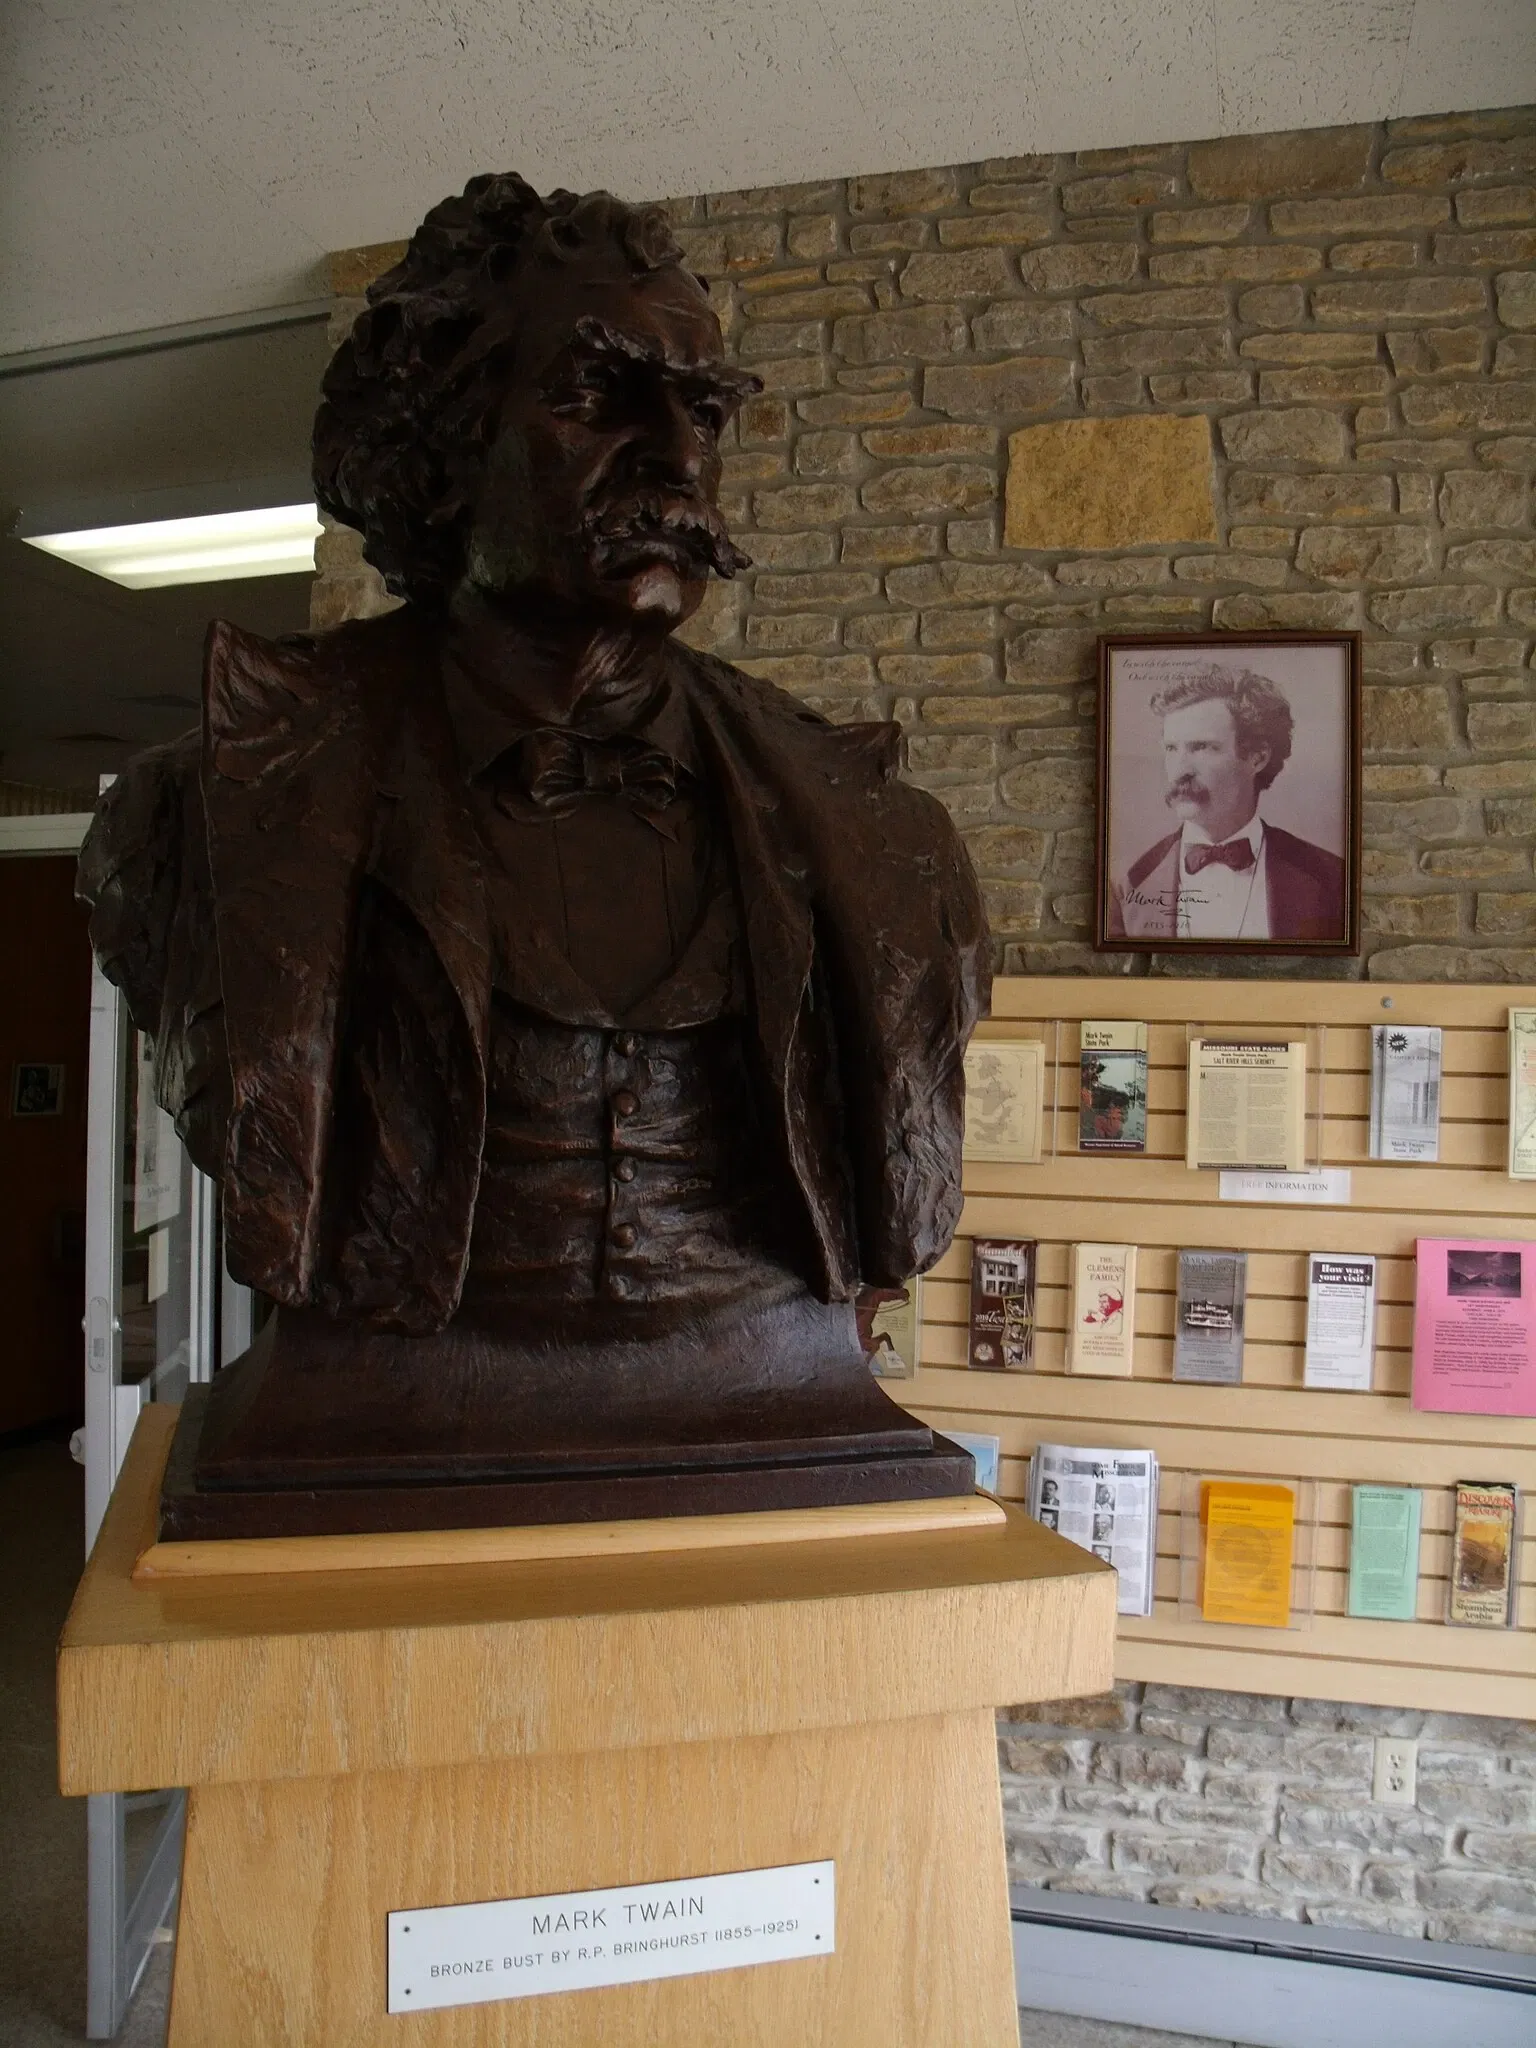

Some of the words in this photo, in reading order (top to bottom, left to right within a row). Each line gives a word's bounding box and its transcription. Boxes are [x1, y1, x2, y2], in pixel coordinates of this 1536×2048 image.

[1125, 889, 1170, 906] Mark
[1241, 1180, 1262, 1189] FREE
[1265, 1181, 1329, 1191] INFORMATION
[1087, 1264, 1126, 1273] CLEMENS
[1321, 1264, 1343, 1273] How
[1090, 1273, 1121, 1281] FAMILY
[1319, 1274, 1342, 1282] your
[1343, 1274, 1370, 1283] visit?
[1456, 1603, 1502, 1613] Steamboat
[1465, 1611, 1493, 1620] Arabia
[532, 1908, 607, 1935] MARK
[623, 1896, 703, 1924] TWAIN
[430, 1959, 494, 1977] BRONZE
[503, 1953, 544, 1970] BUST
[551, 1949, 570, 1963] BY
[578, 1946, 606, 1960] R.P.
[614, 1931, 708, 1956] BRINGHURST
[715, 1919, 799, 1942] (1855-1925)
